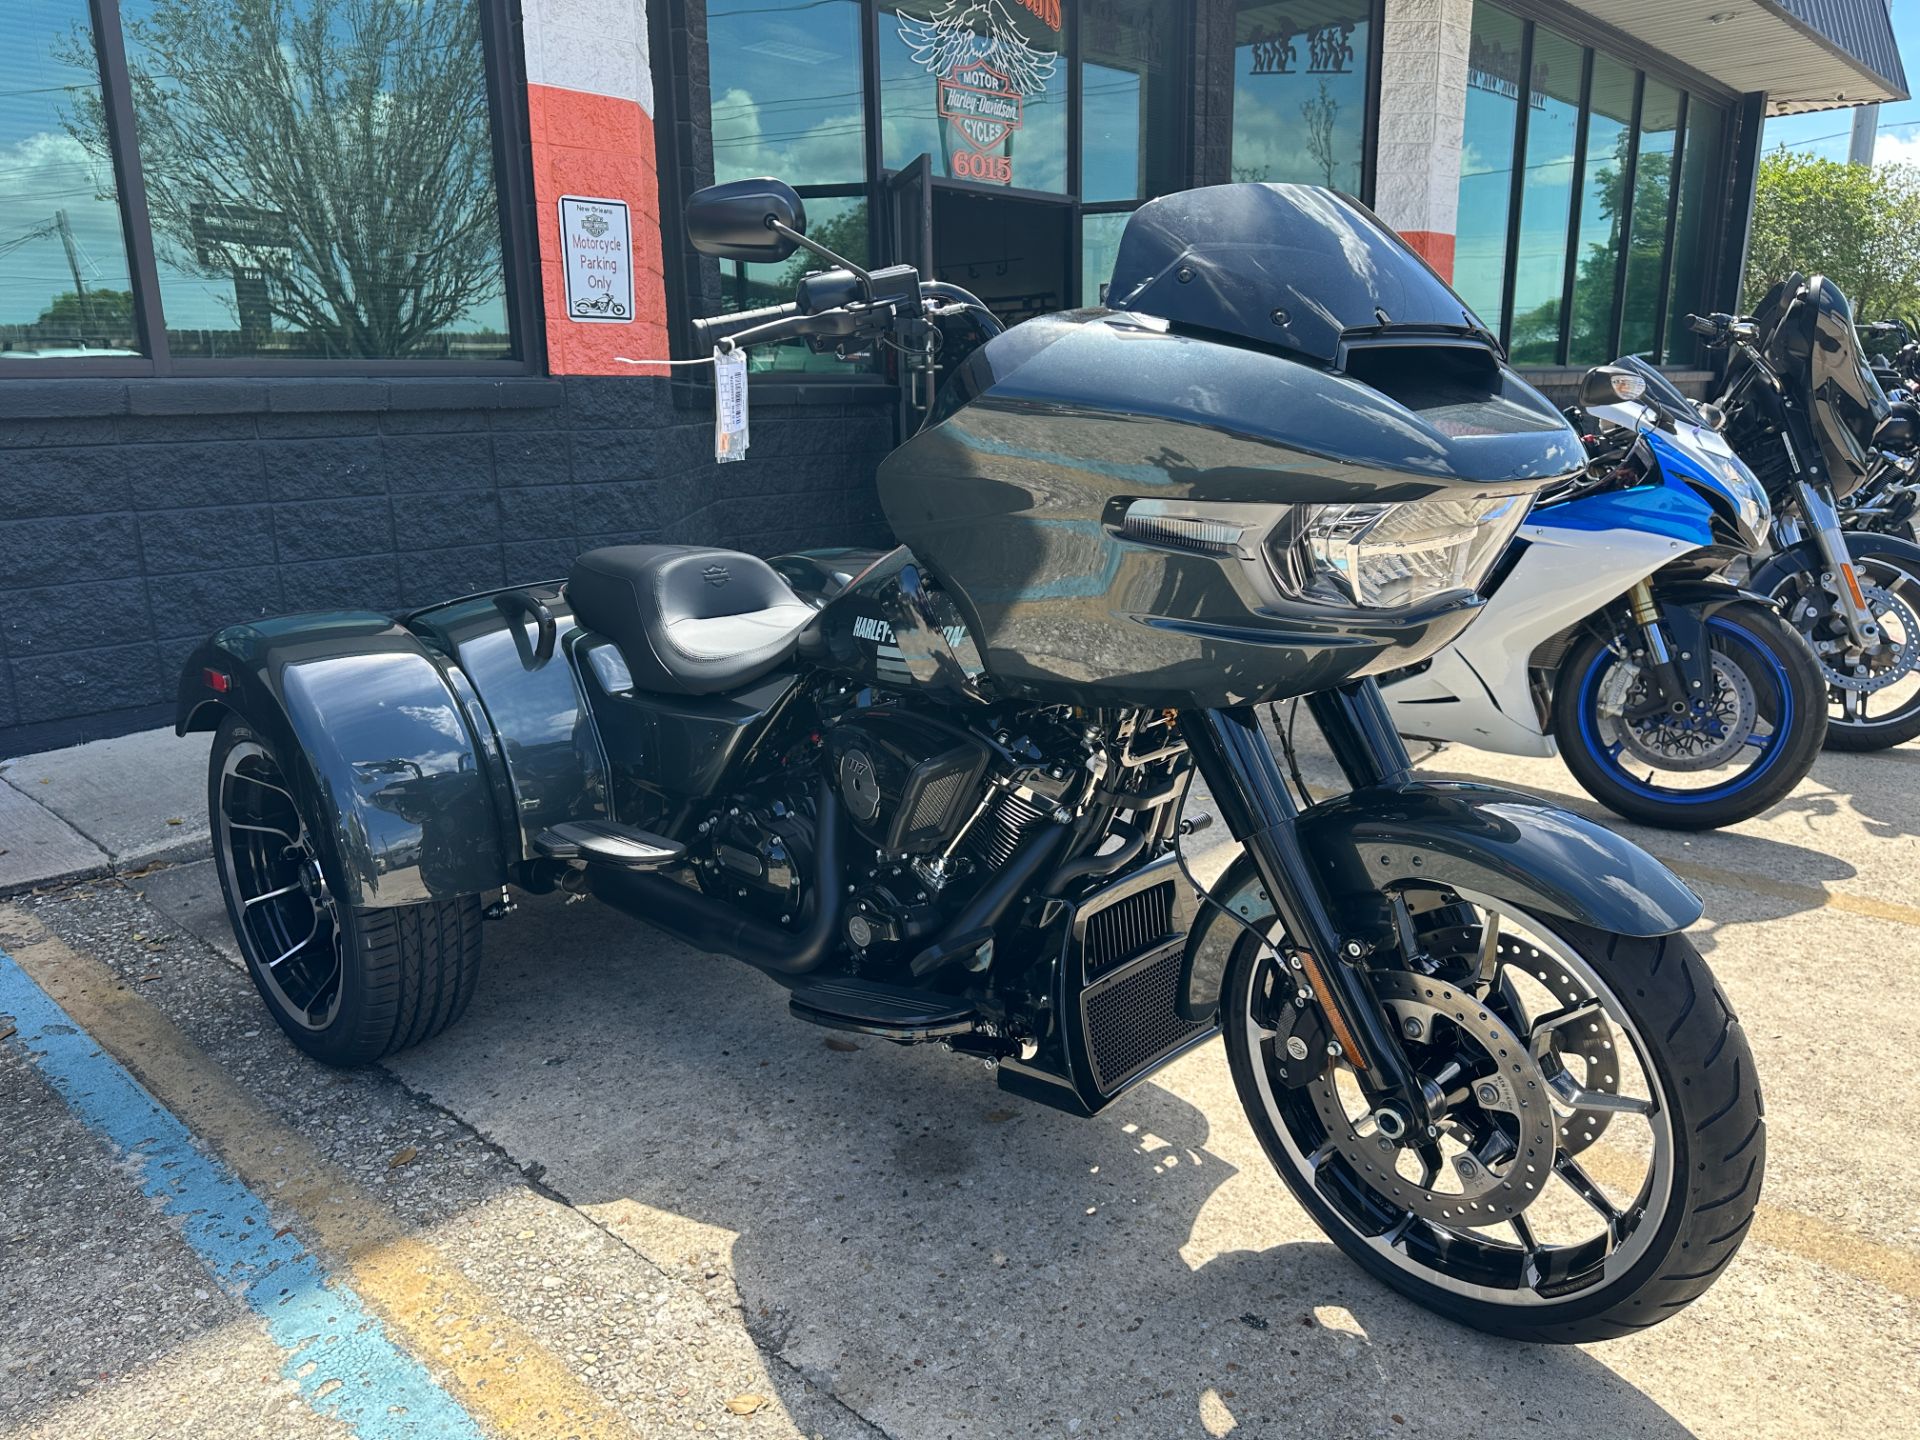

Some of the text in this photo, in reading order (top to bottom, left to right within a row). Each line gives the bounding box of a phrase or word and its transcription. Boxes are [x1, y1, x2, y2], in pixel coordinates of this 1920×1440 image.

[963, 71, 999, 90] MOTOR
[944, 87, 1019, 120] Harley-Davidson
[964, 119, 1001, 142] CYCLES
[953, 151, 1012, 183] 6015
[576, 204, 590, 212] New
[572, 234, 621, 254] Motorcycle
[581, 254, 617, 274] Parking
[588, 275, 612, 292] Only
